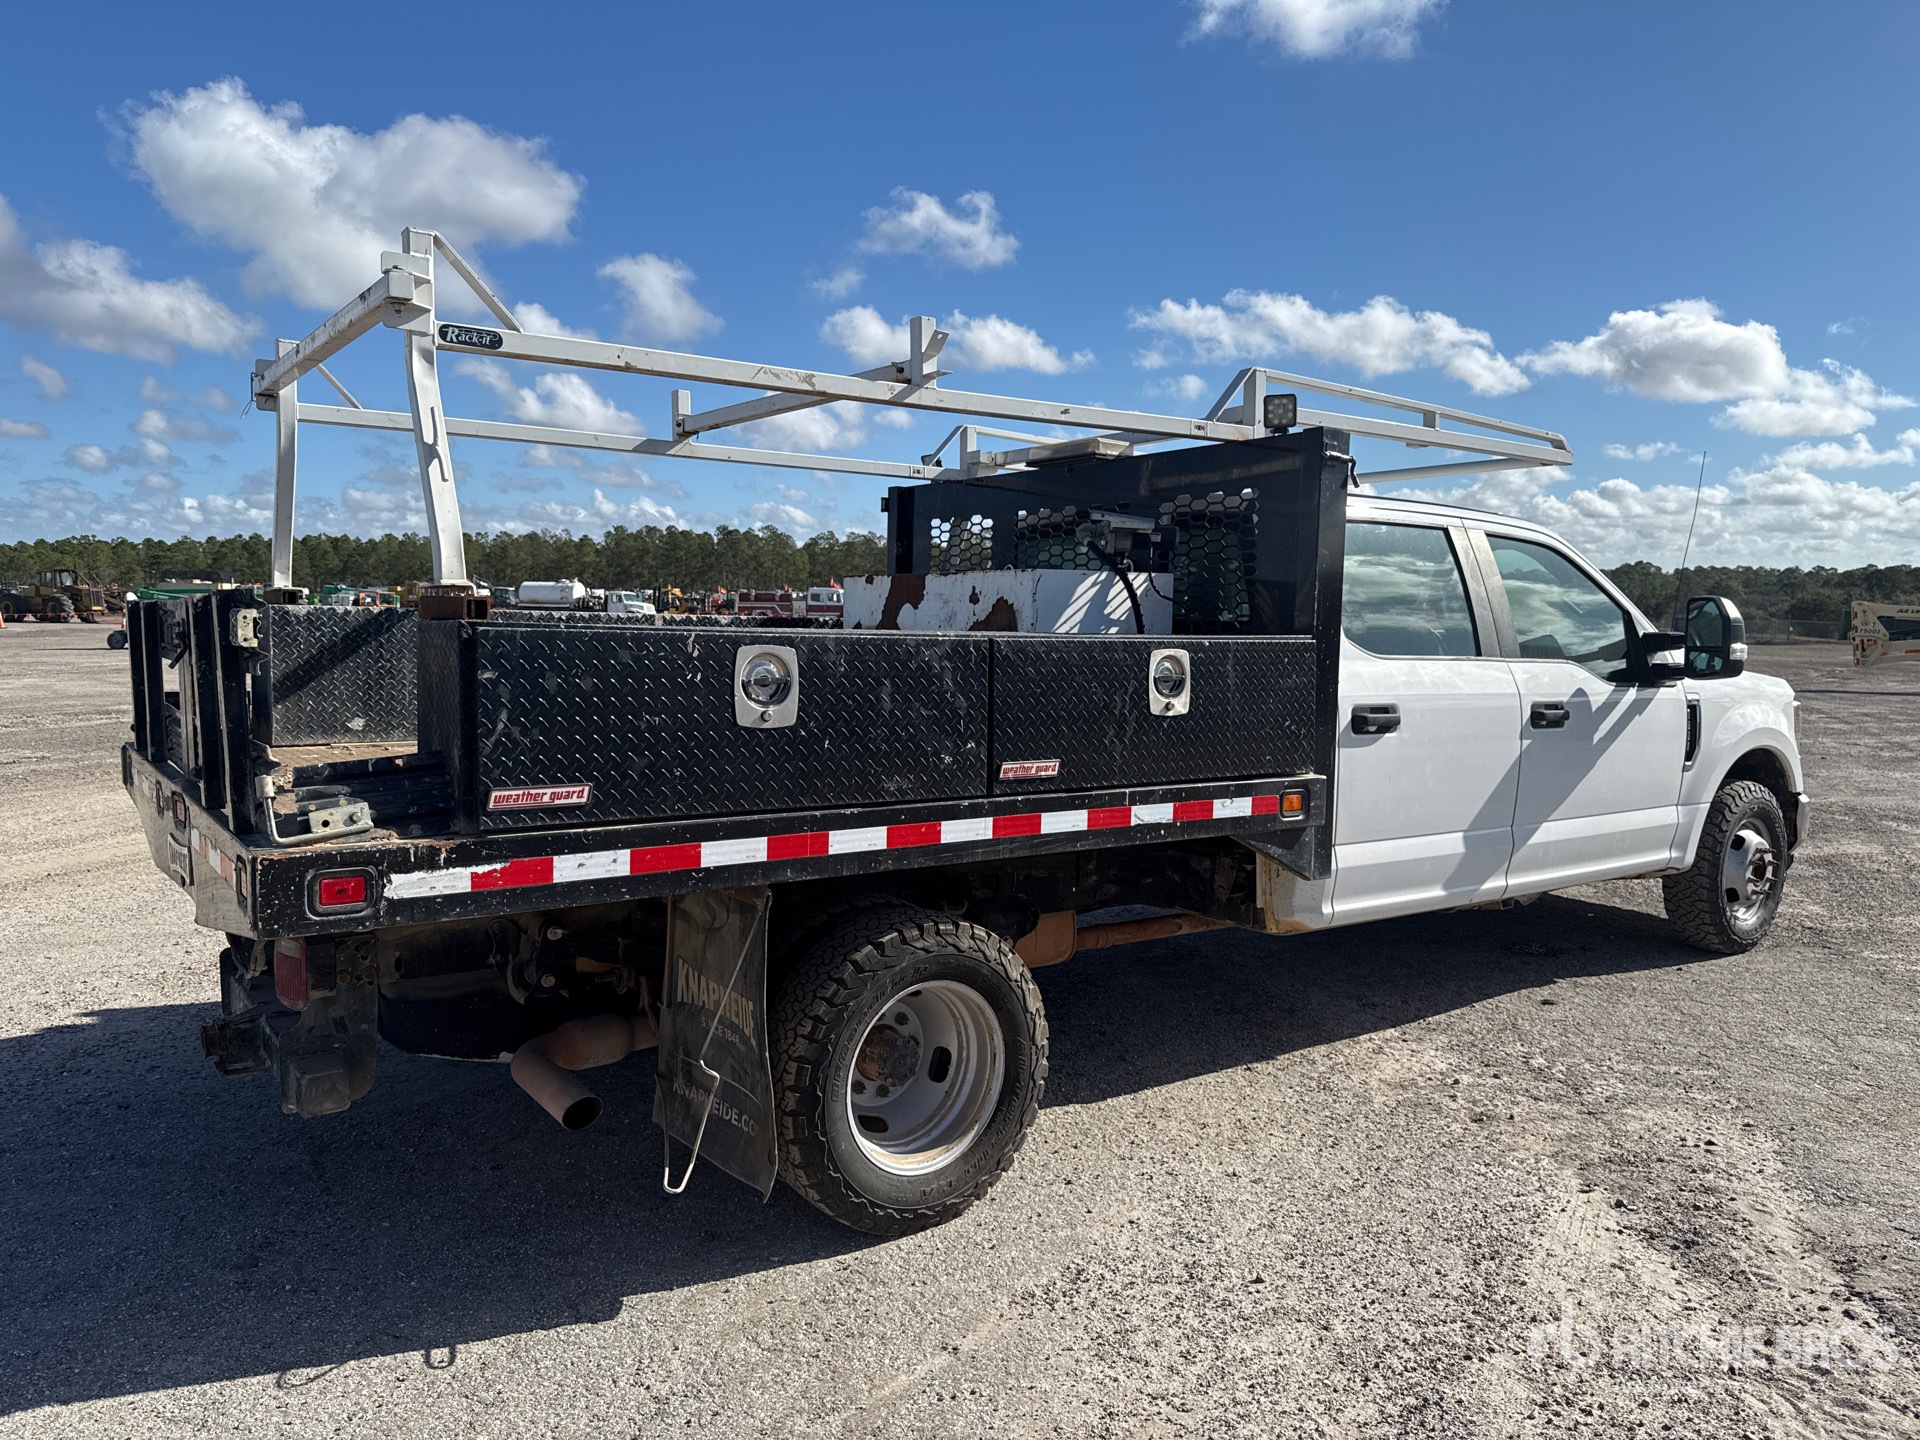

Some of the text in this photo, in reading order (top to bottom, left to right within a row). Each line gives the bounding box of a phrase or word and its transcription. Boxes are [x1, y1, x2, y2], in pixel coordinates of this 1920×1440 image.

[445, 326, 491, 345] Rack-it
[1003, 763, 1056, 775] weather guard
[493, 787, 585, 804] weather guard
